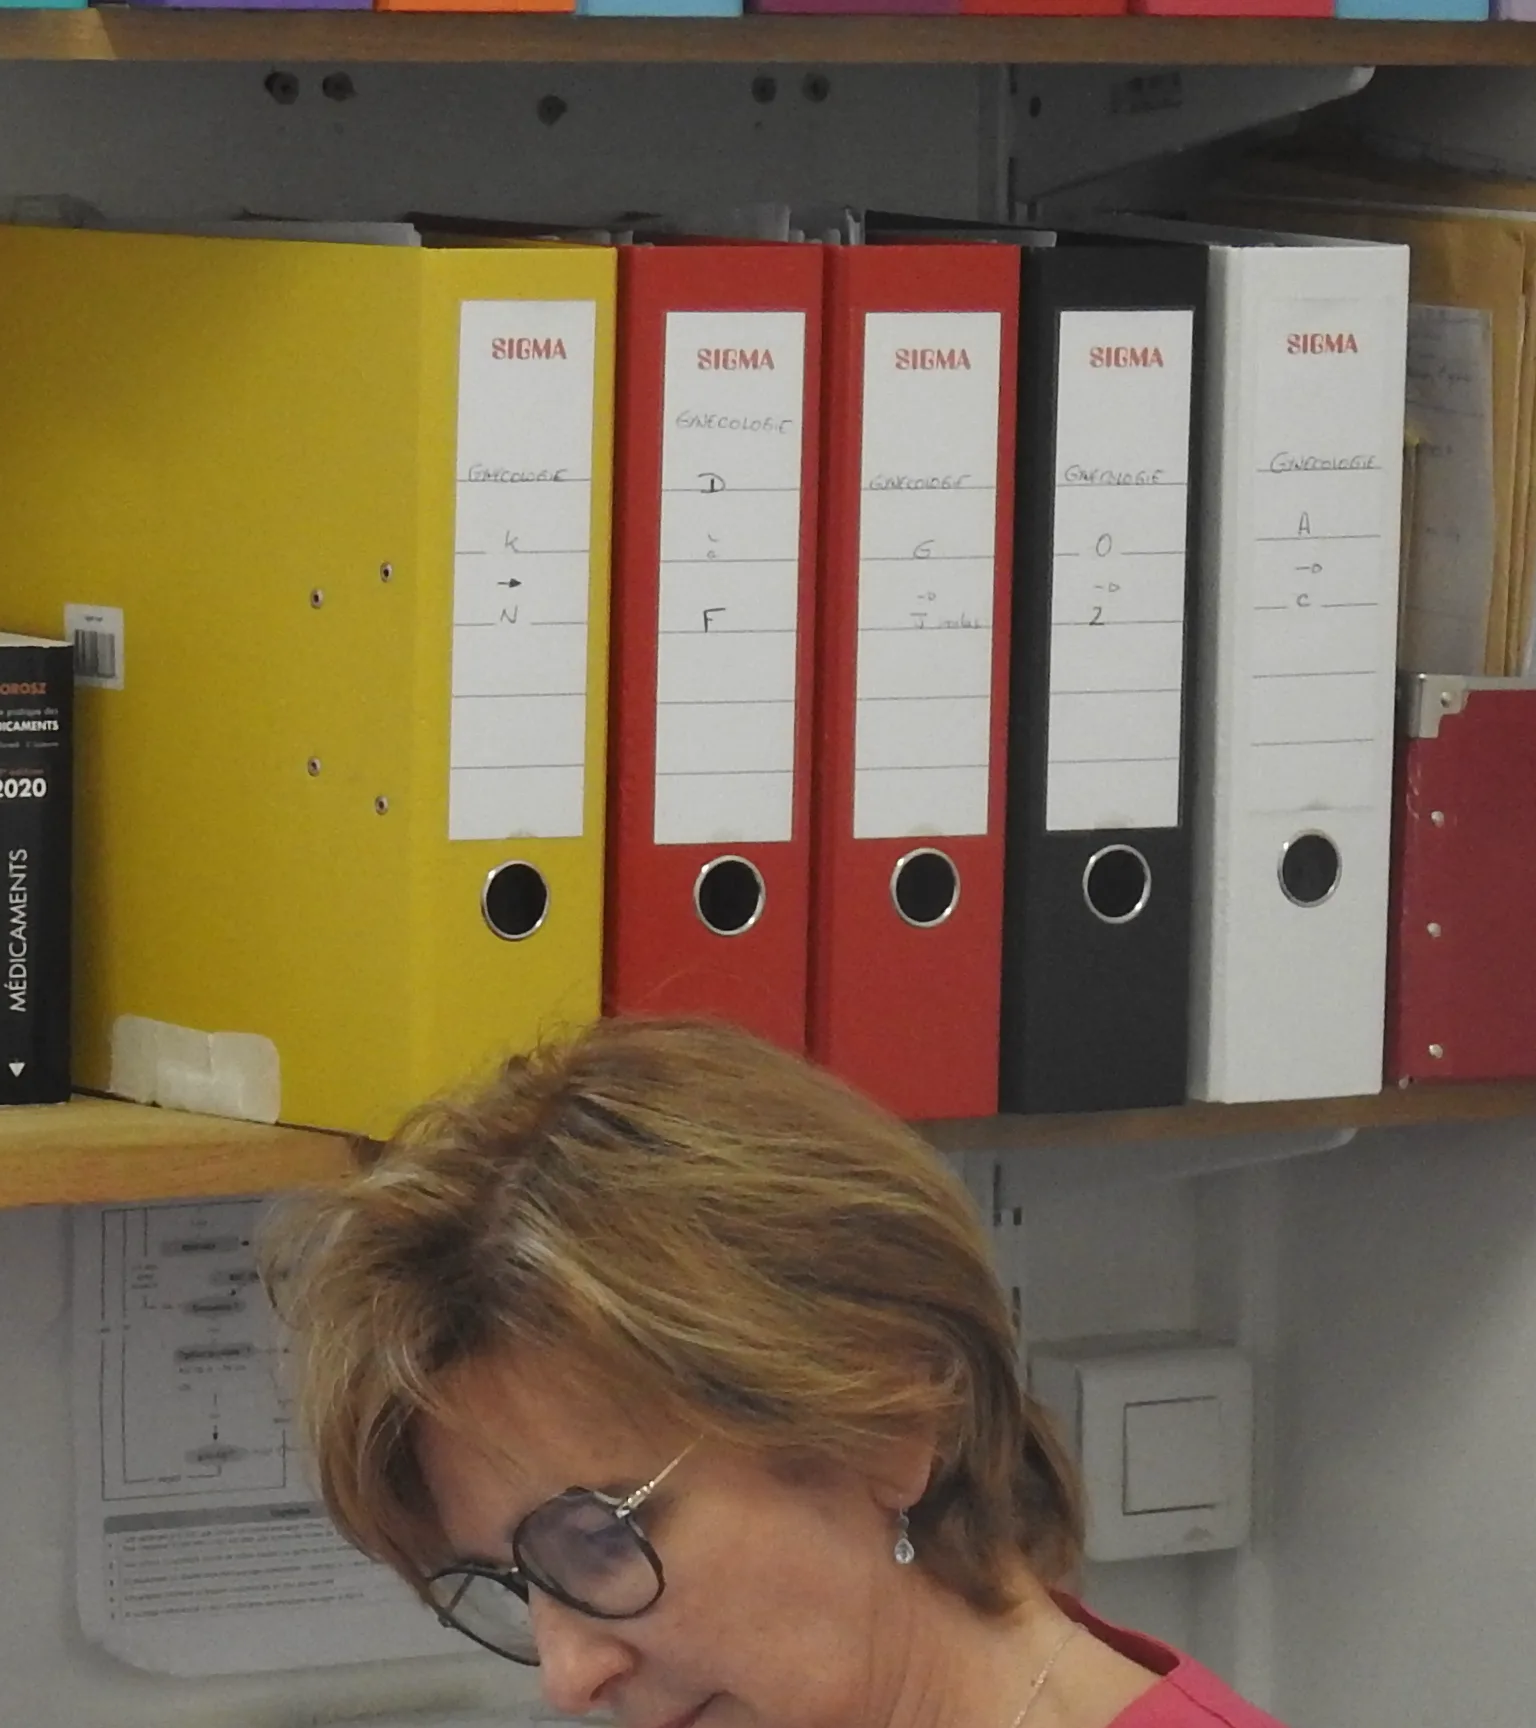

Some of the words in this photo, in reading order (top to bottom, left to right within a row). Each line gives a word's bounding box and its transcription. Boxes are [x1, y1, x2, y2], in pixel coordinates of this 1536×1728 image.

[491, 336, 568, 362] SIGMA
[1285, 333, 1359, 356] SIGMA
[696, 348, 776, 372] SIGMA
[894, 348, 972, 372] SIGMA
[1088, 345, 1165, 369] SIGMA
[703, 607, 726, 633] F
[4, 848, 29, 1013] MÉDICAMENTS
